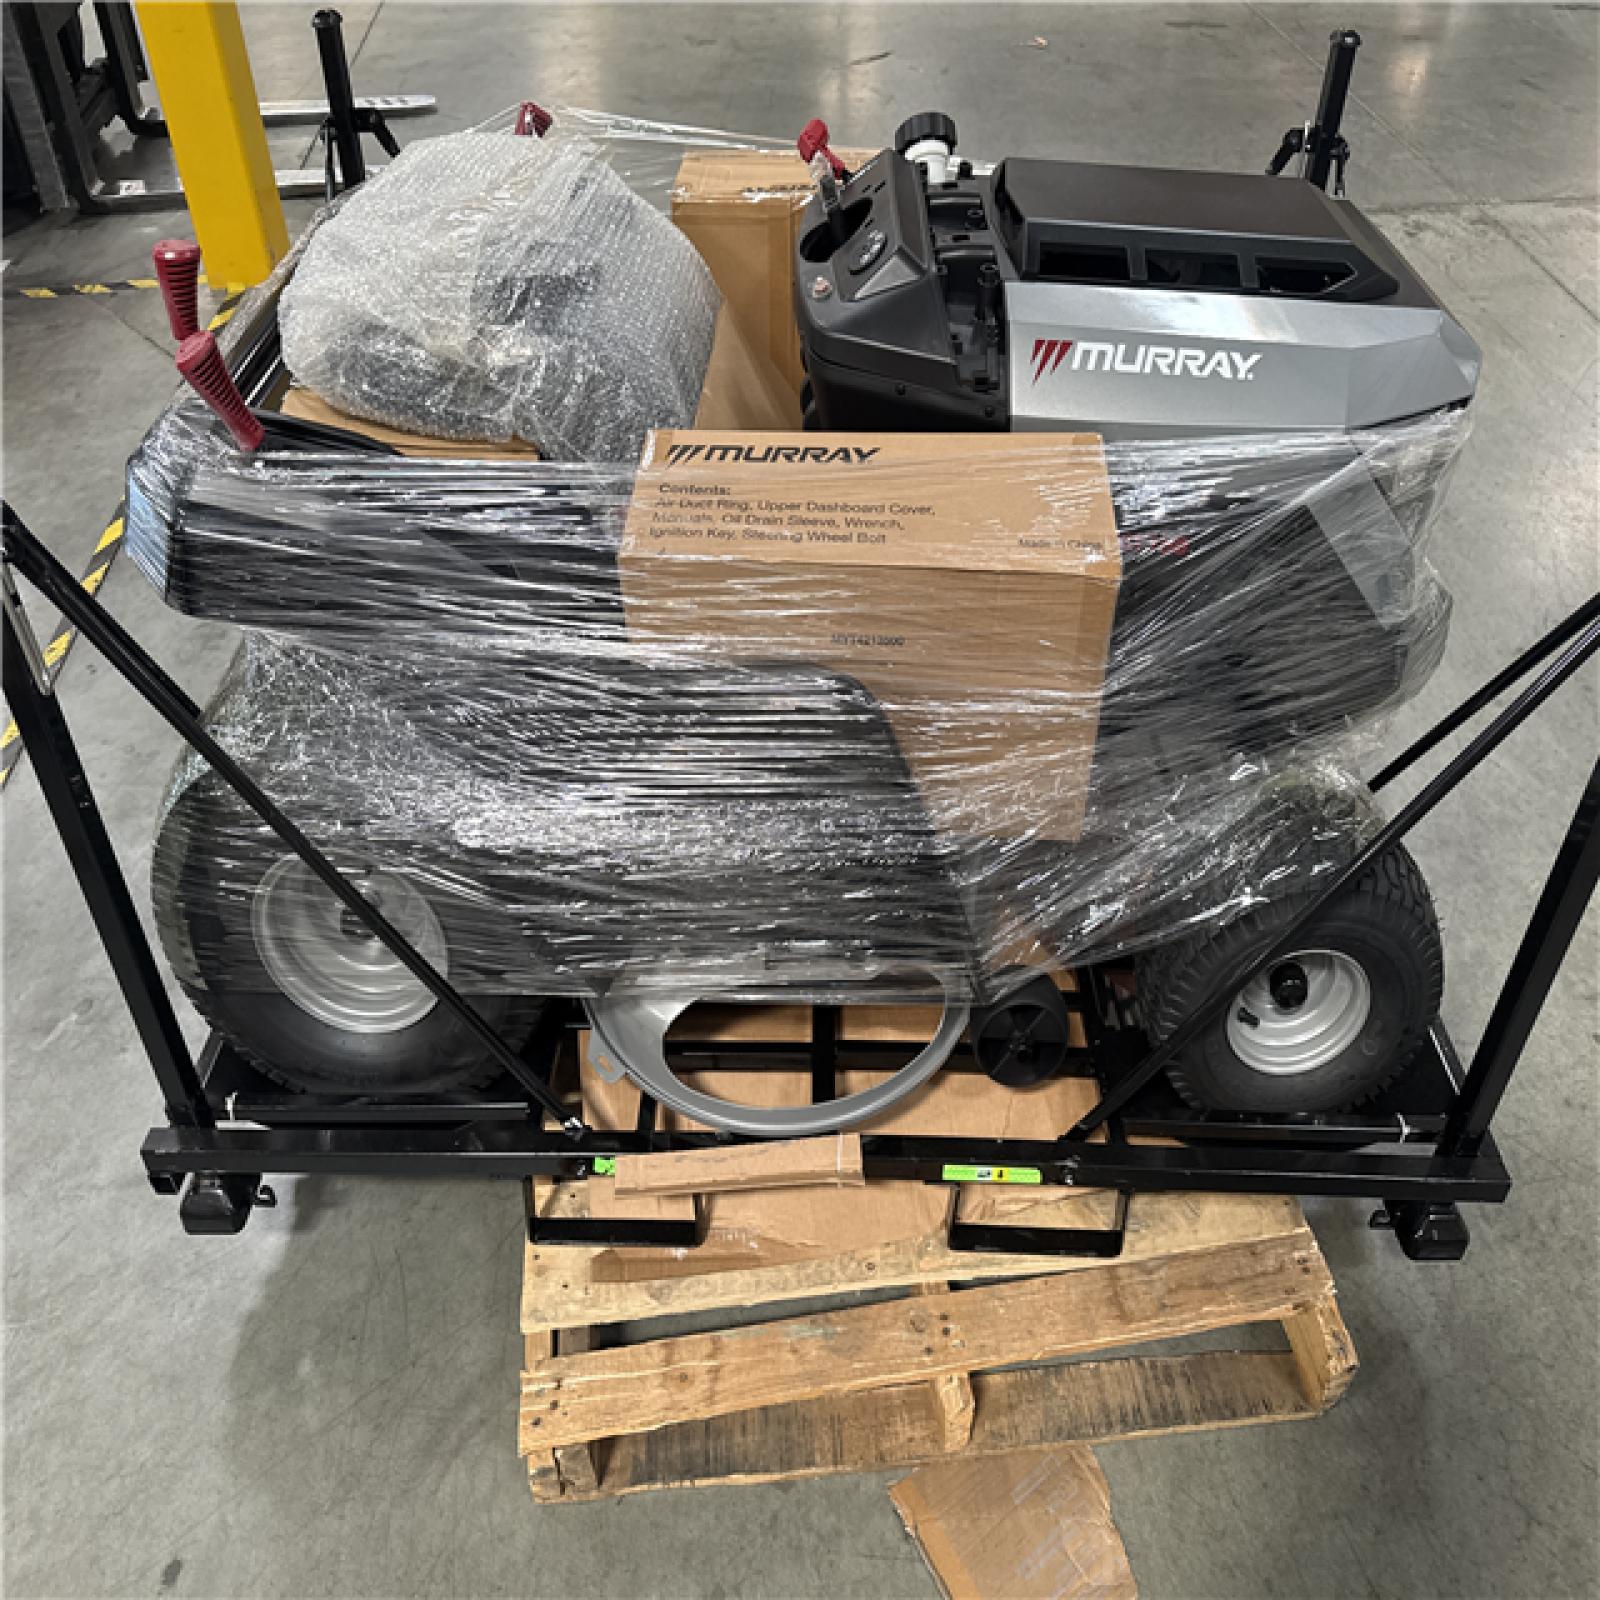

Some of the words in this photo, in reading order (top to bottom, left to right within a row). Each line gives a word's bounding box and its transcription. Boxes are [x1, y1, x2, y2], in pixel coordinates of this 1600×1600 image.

[703, 444, 881, 464] MURRAY
[659, 482, 731, 496] Contents:
[757, 500, 801, 512] Upper
[807, 500, 886, 514] Dashboard
[889, 502, 936, 516] Cover,
[745, 514, 783, 526] Drain
[807, 530, 853, 543] Wheel
[857, 532, 887, 544] Bolt
